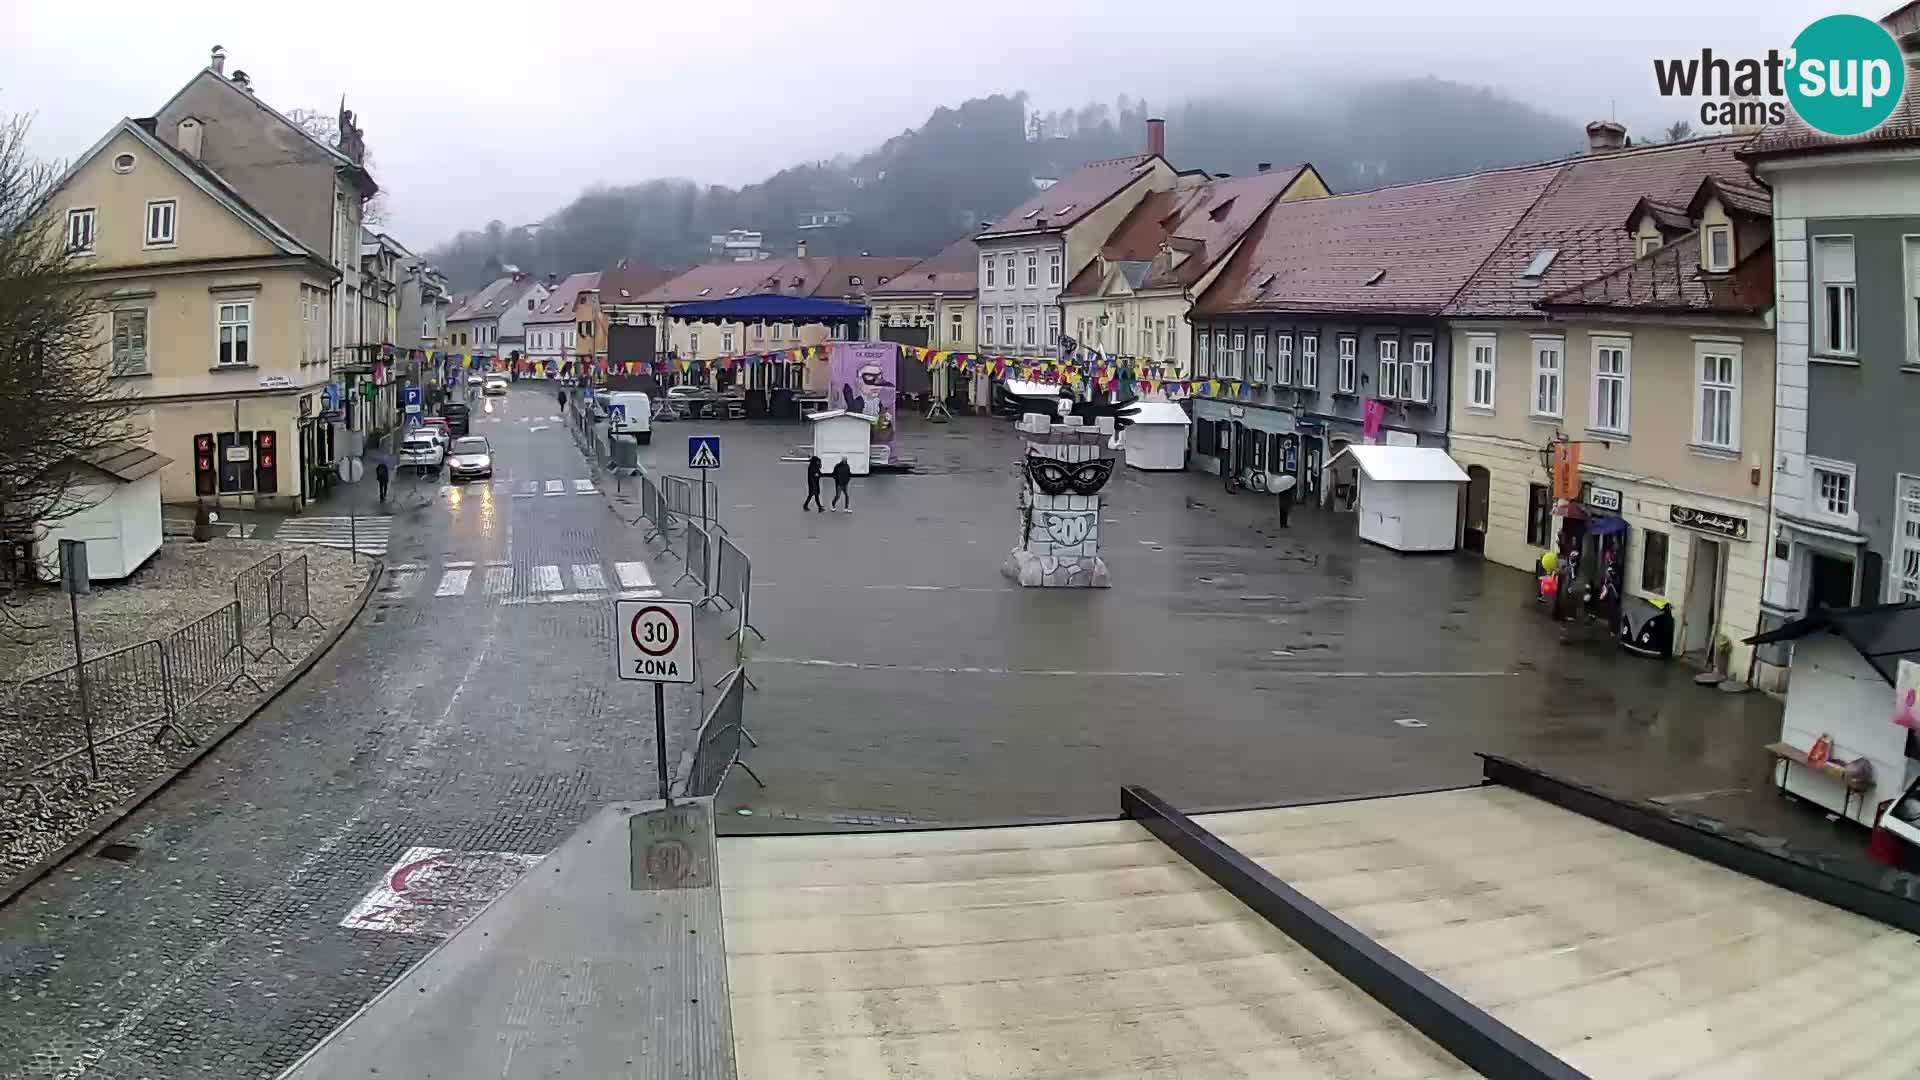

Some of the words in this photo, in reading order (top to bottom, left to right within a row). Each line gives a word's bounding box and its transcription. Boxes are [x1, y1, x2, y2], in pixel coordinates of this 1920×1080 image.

[408, 391, 417, 403] P
[644, 622, 668, 643] 30
[634, 660, 679, 676] ZONA
